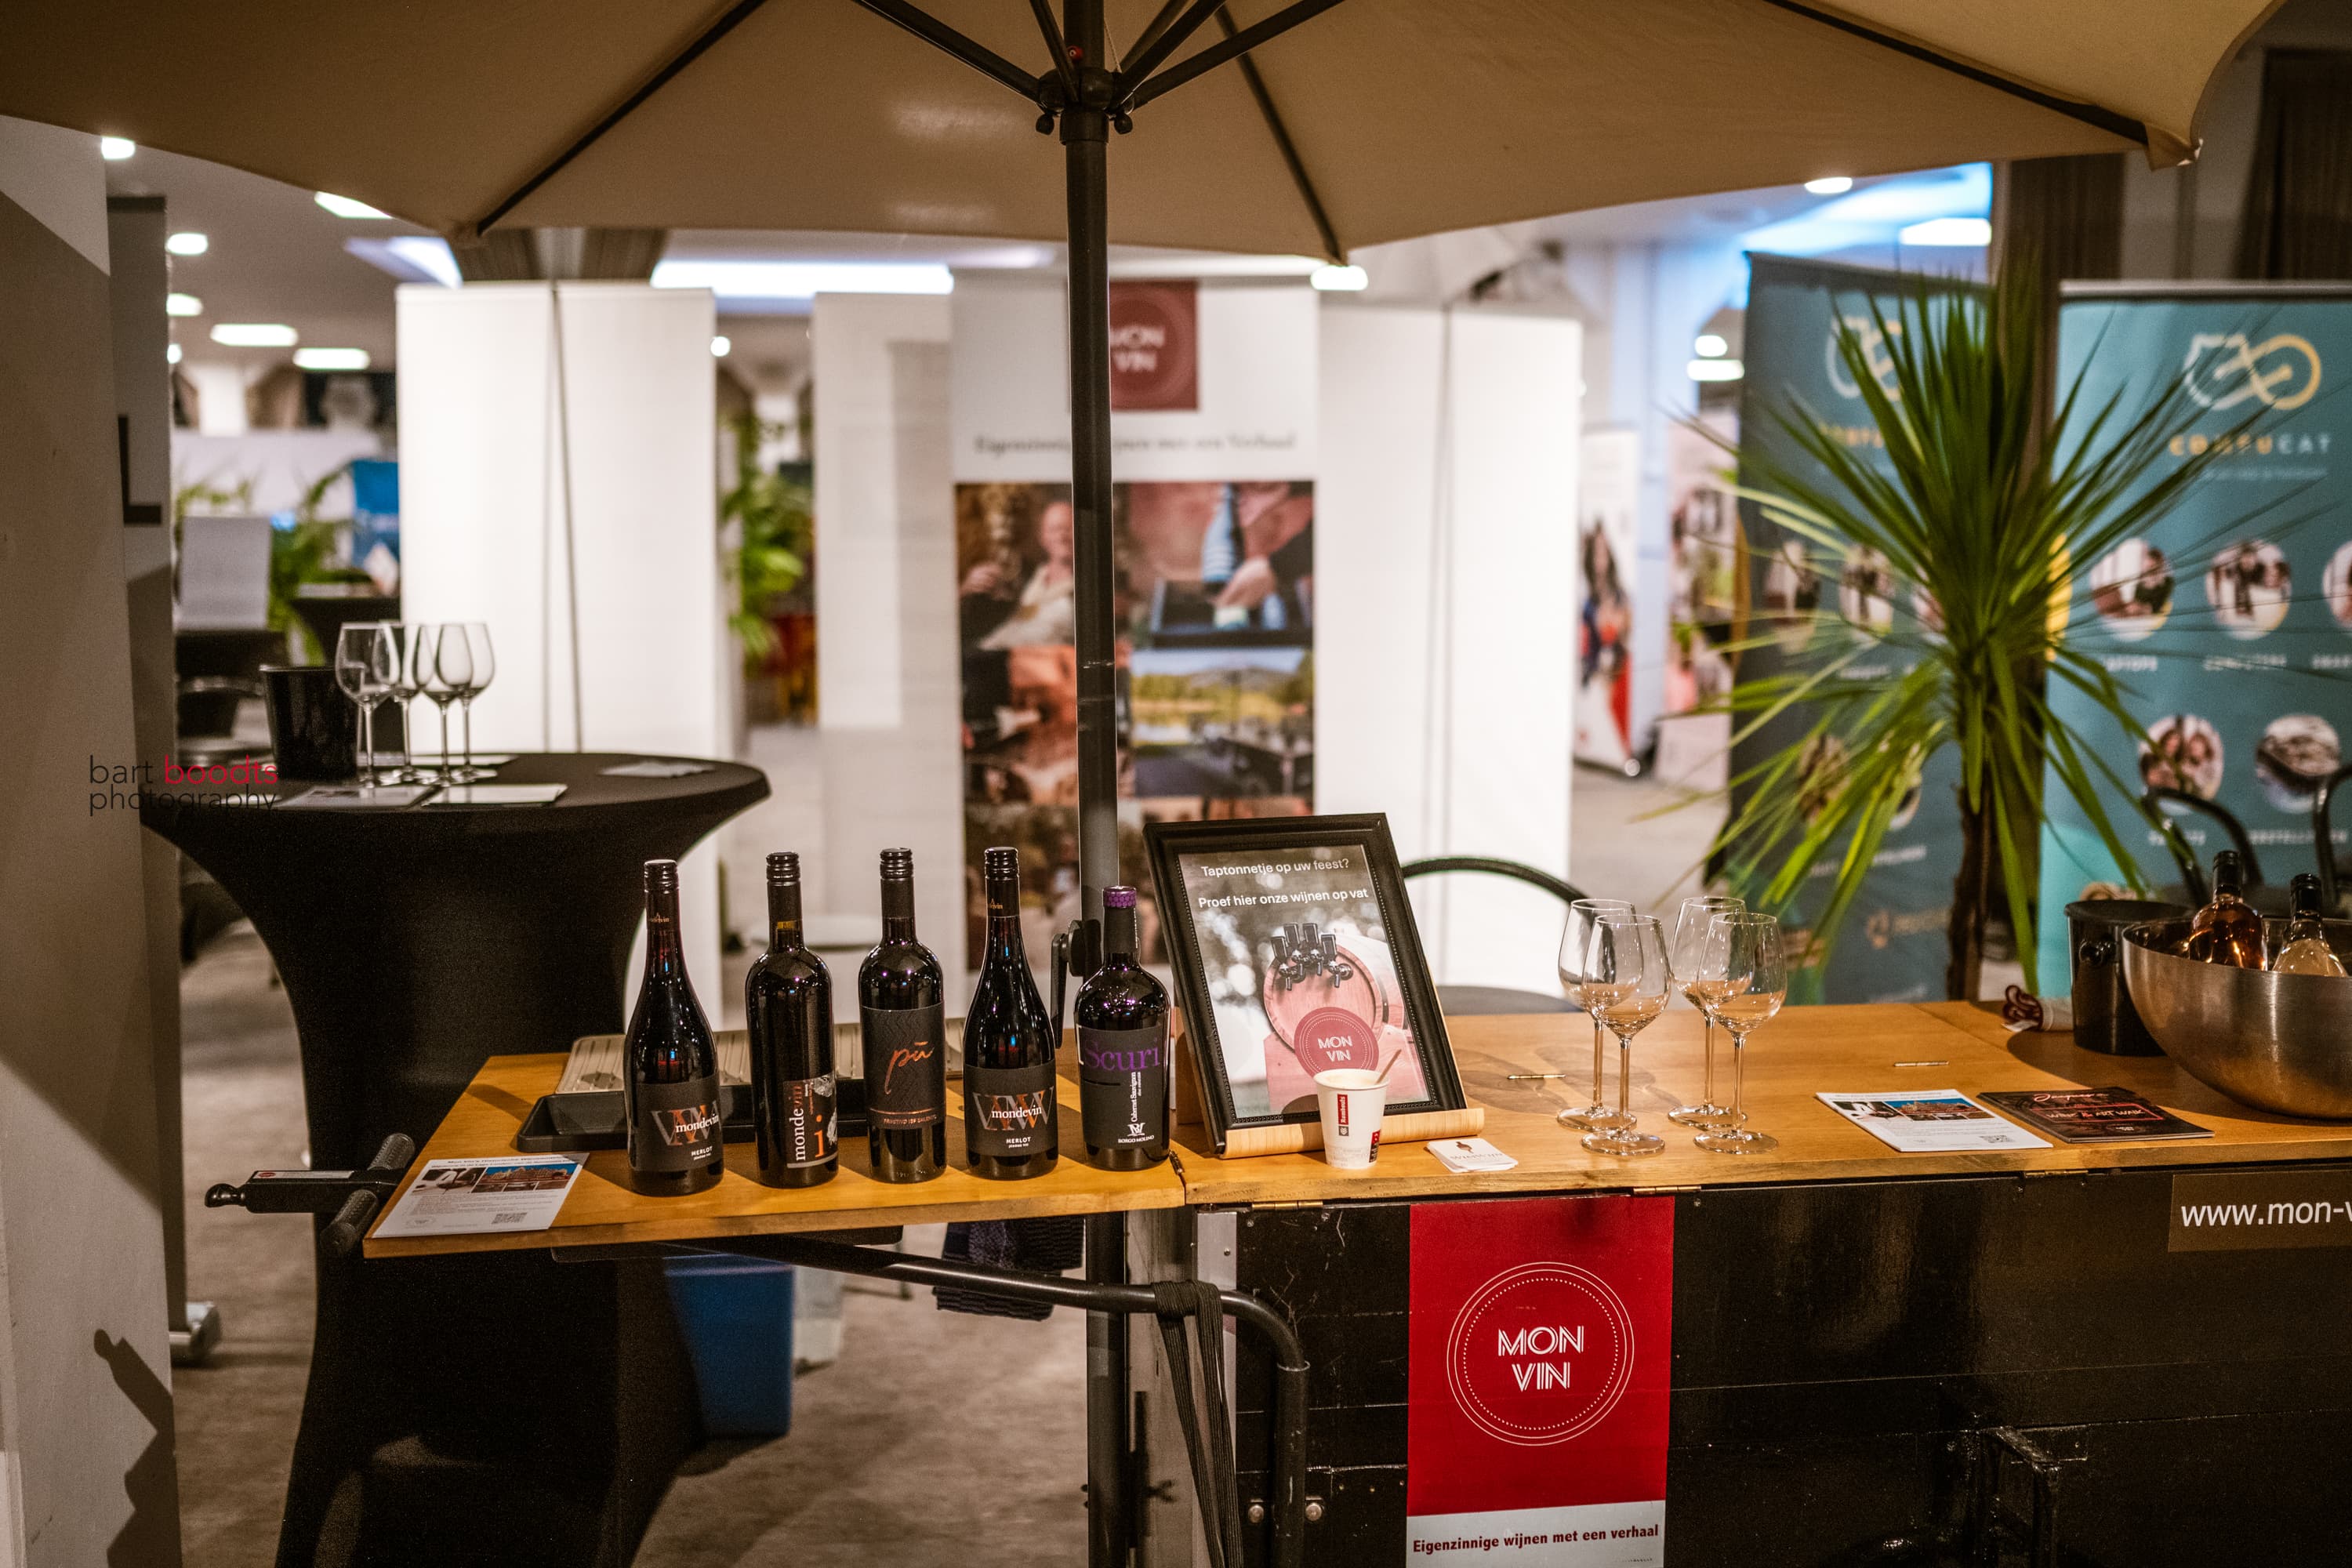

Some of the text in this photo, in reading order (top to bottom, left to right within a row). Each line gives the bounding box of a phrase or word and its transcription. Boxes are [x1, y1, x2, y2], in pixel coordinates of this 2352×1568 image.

[1201, 858, 1349, 877] Taptonnetje op uw feest?
[1198, 888, 1368, 908] Proef hier onze wijnen op vat
[1317, 1035, 1352, 1049] MON
[1084, 1037, 1160, 1071] Scuri
[1326, 1050, 1351, 1062] VIN
[991, 1105, 1042, 1119] mondevin
[676, 1113, 719, 1133] mondevin
[691, 1145, 713, 1156] MERLOT
[1497, 1325, 1584, 1357] MON
[1512, 1361, 1570, 1392] VIN
[1413, 1524, 1659, 1555] Eigenzinnige wijnen met een verhaal
